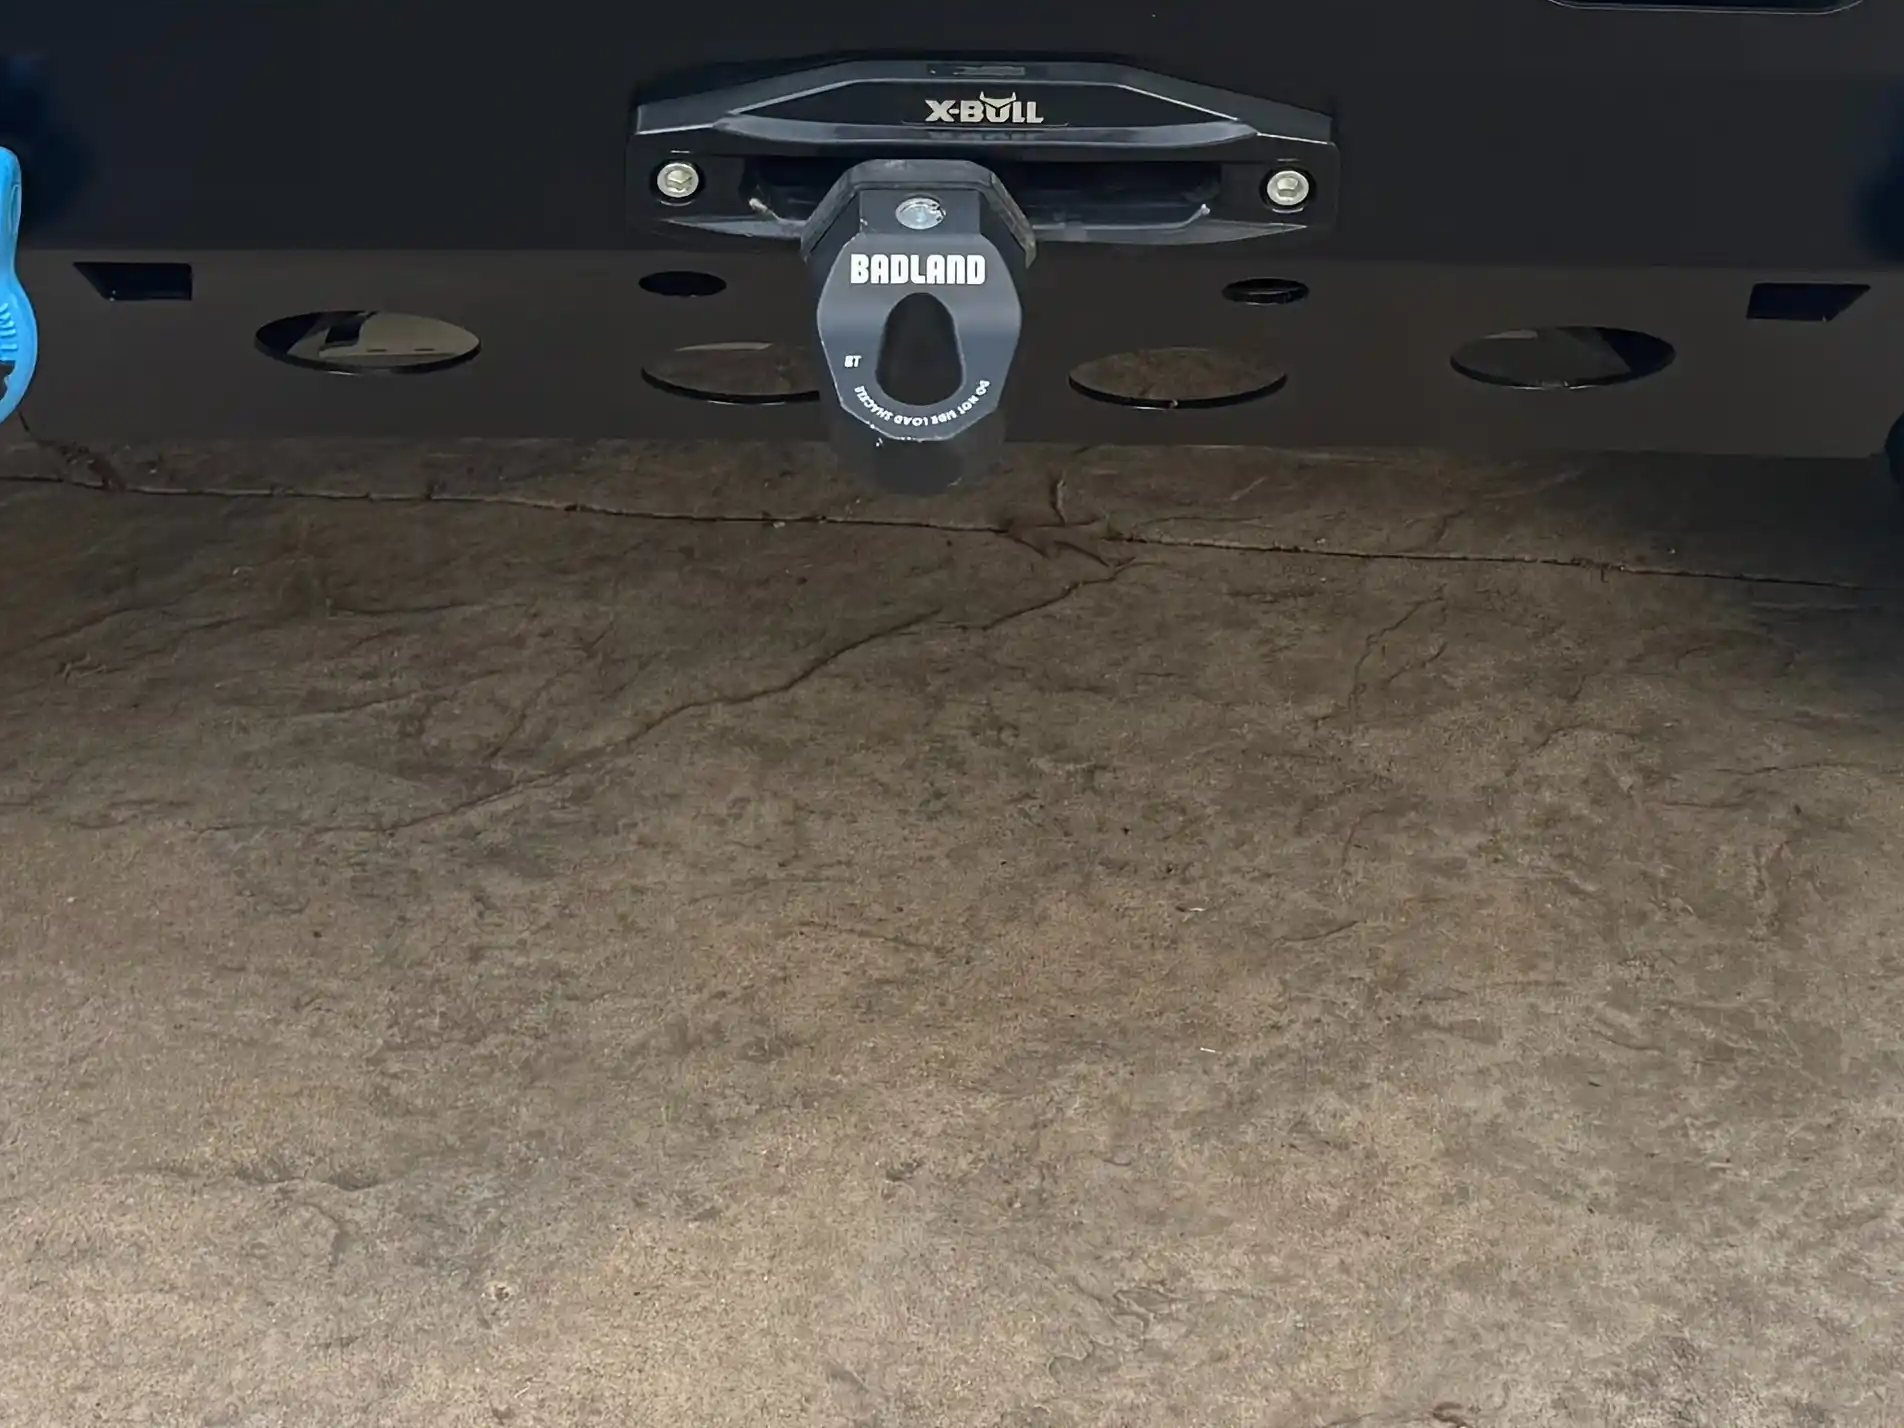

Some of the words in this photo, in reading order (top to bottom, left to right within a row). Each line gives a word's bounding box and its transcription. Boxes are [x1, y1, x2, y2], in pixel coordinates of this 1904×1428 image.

[925, 91, 1044, 124] X-BULL
[850, 253, 986, 285] BADLAND
[975, 379, 991, 396] DO
[957, 394, 980, 415] NOT
[893, 415, 929, 427] LOAD
